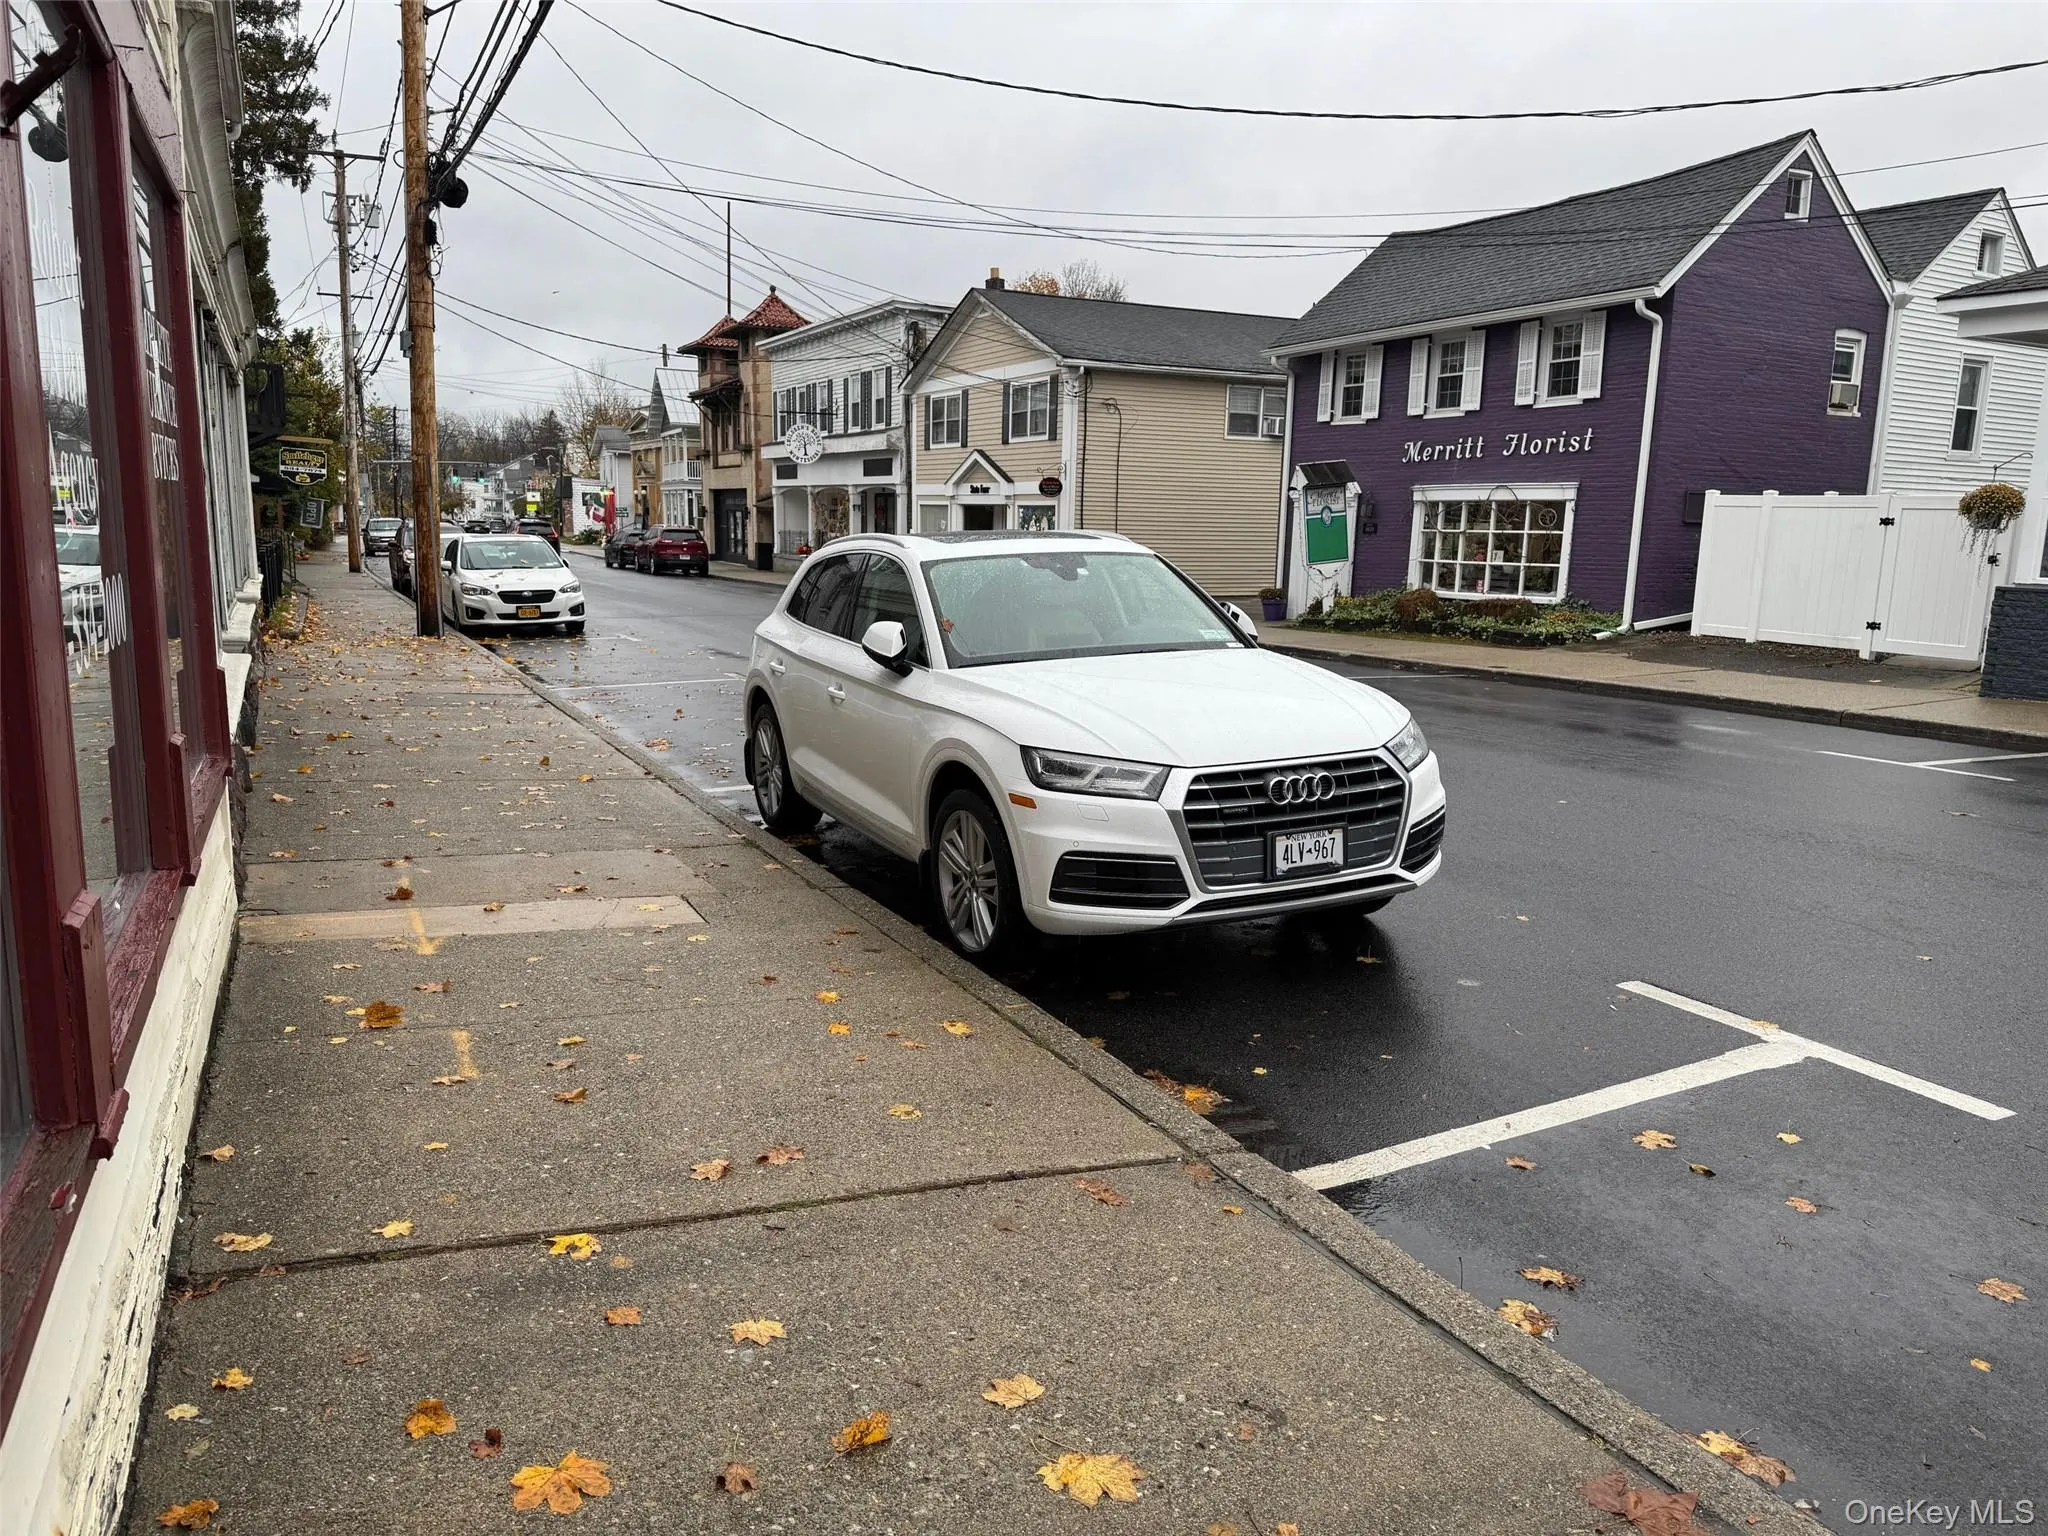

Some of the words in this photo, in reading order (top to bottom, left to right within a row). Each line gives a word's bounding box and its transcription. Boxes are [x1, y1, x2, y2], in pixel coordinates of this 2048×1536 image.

[27, 176, 85, 311] Robert
[1402, 435, 1485, 463] Merritt
[1502, 427, 1595, 456] Florist
[48, 420, 100, 537] Agency
[305, 501, 317, 523] OPEN
[1291, 833, 1308, 842] NEW
[1309, 829, 1327, 840] YORK
